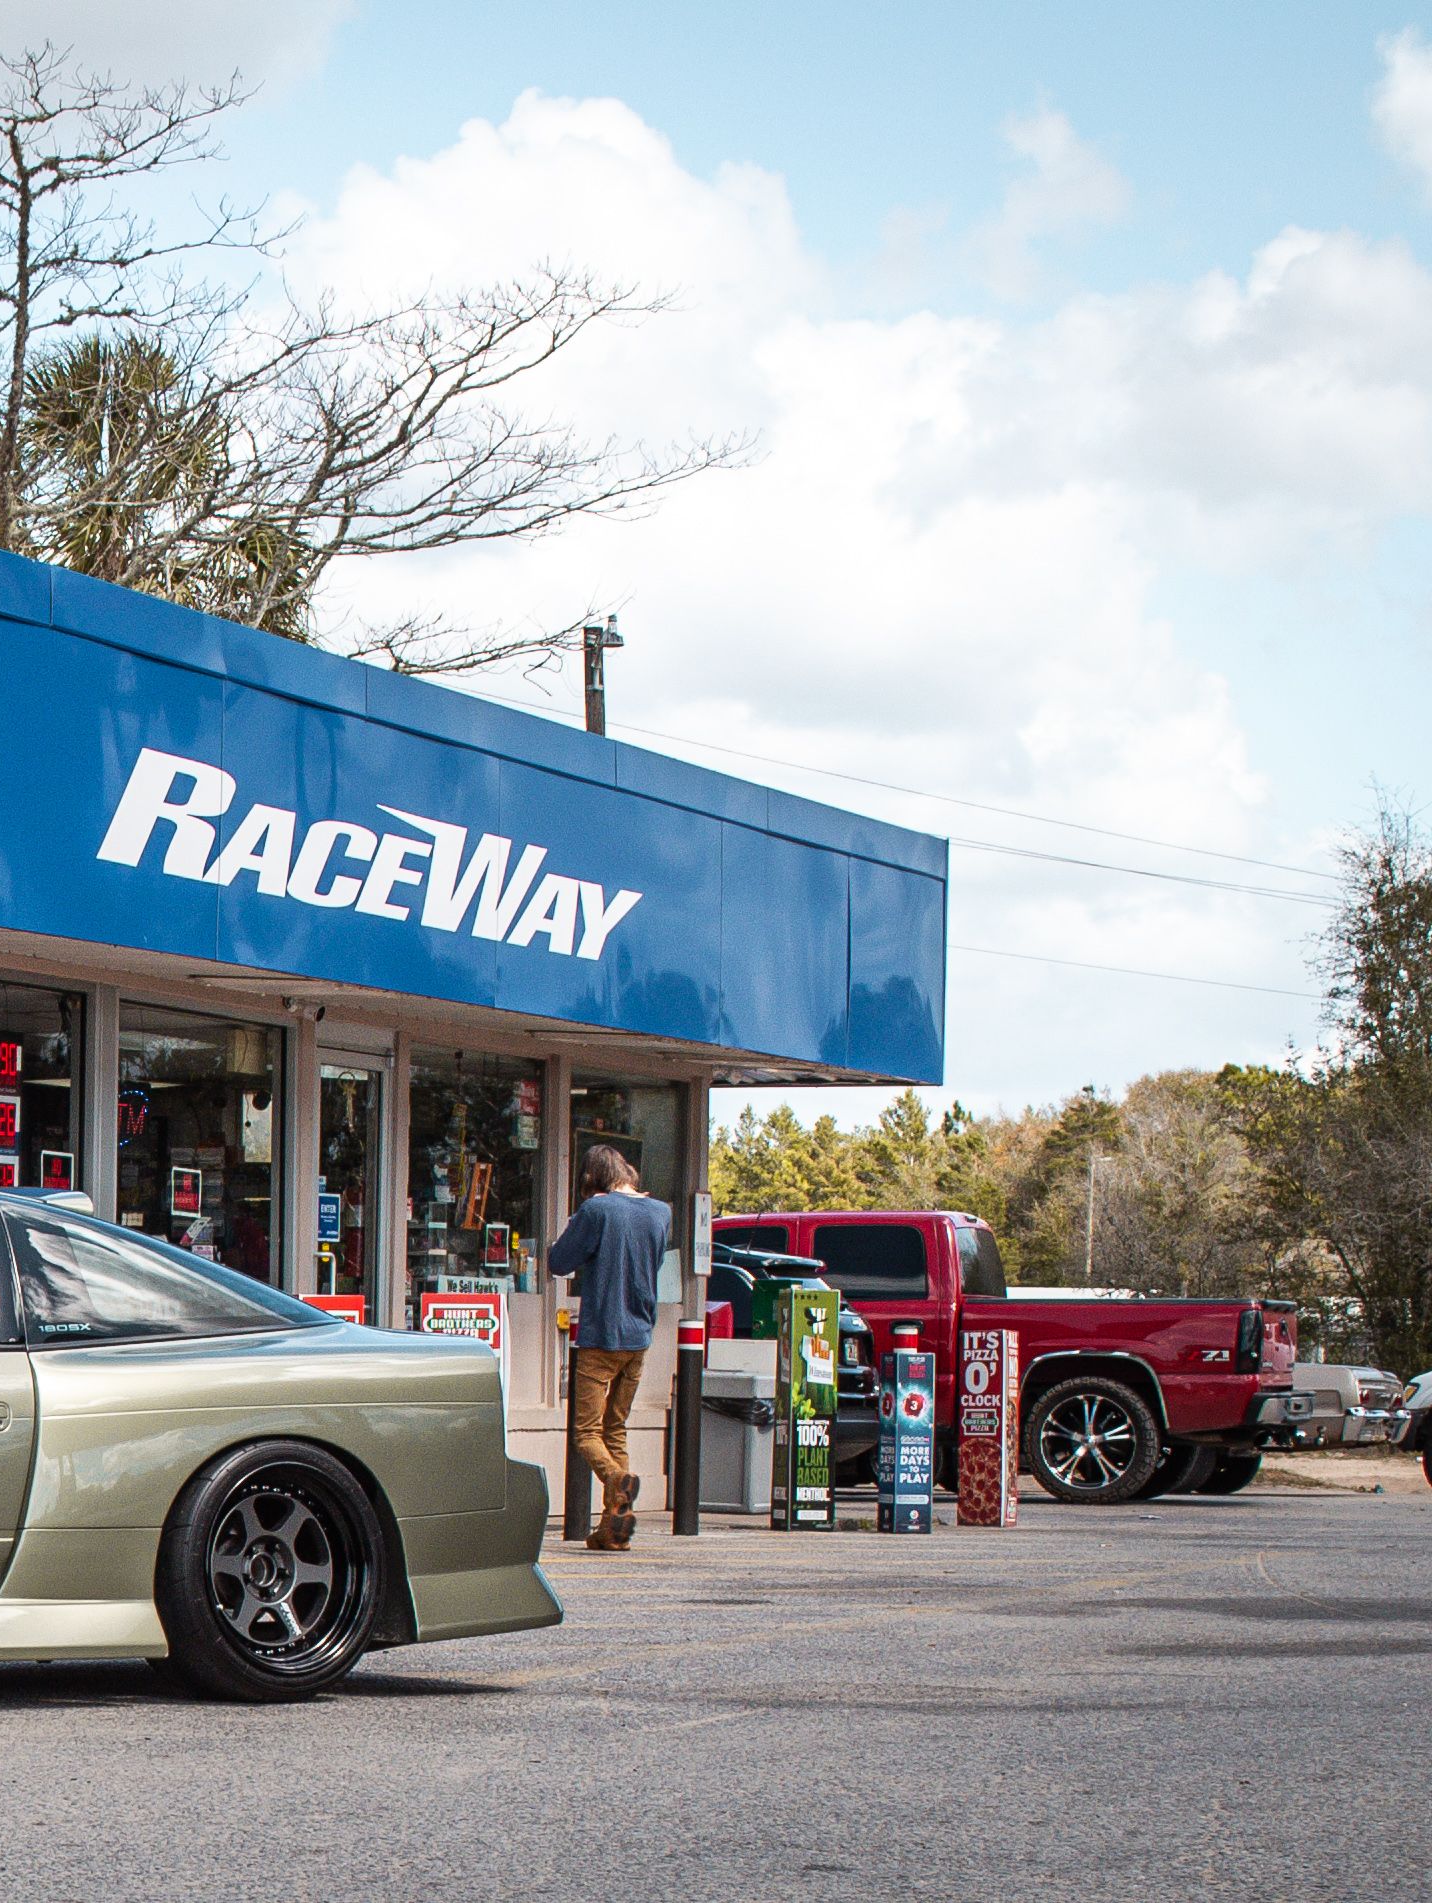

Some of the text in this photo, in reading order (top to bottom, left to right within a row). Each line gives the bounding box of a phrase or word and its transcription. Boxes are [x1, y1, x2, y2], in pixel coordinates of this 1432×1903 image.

[0, 1042, 16, 1076] 90
[118, 1103, 147, 1135] TM
[443, 1309, 477, 1319] HUNT
[39, 1322, 91, 1333] 180SX
[429, 1318, 493, 1329] BROTHERS
[963, 1332, 1000, 1349] IT'S
[963, 1350, 999, 1361] PIZZA
[961, 1395, 1000, 1407] CLOCK
[796, 1425, 830, 1447] 100%
[900, 1446, 930, 1456] MORE
[797, 1447, 830, 1467] PLANT
[900, 1455, 930, 1466] DAYS
[796, 1467, 830, 1486] BASED
[899, 1473, 930, 1484] PLAY
